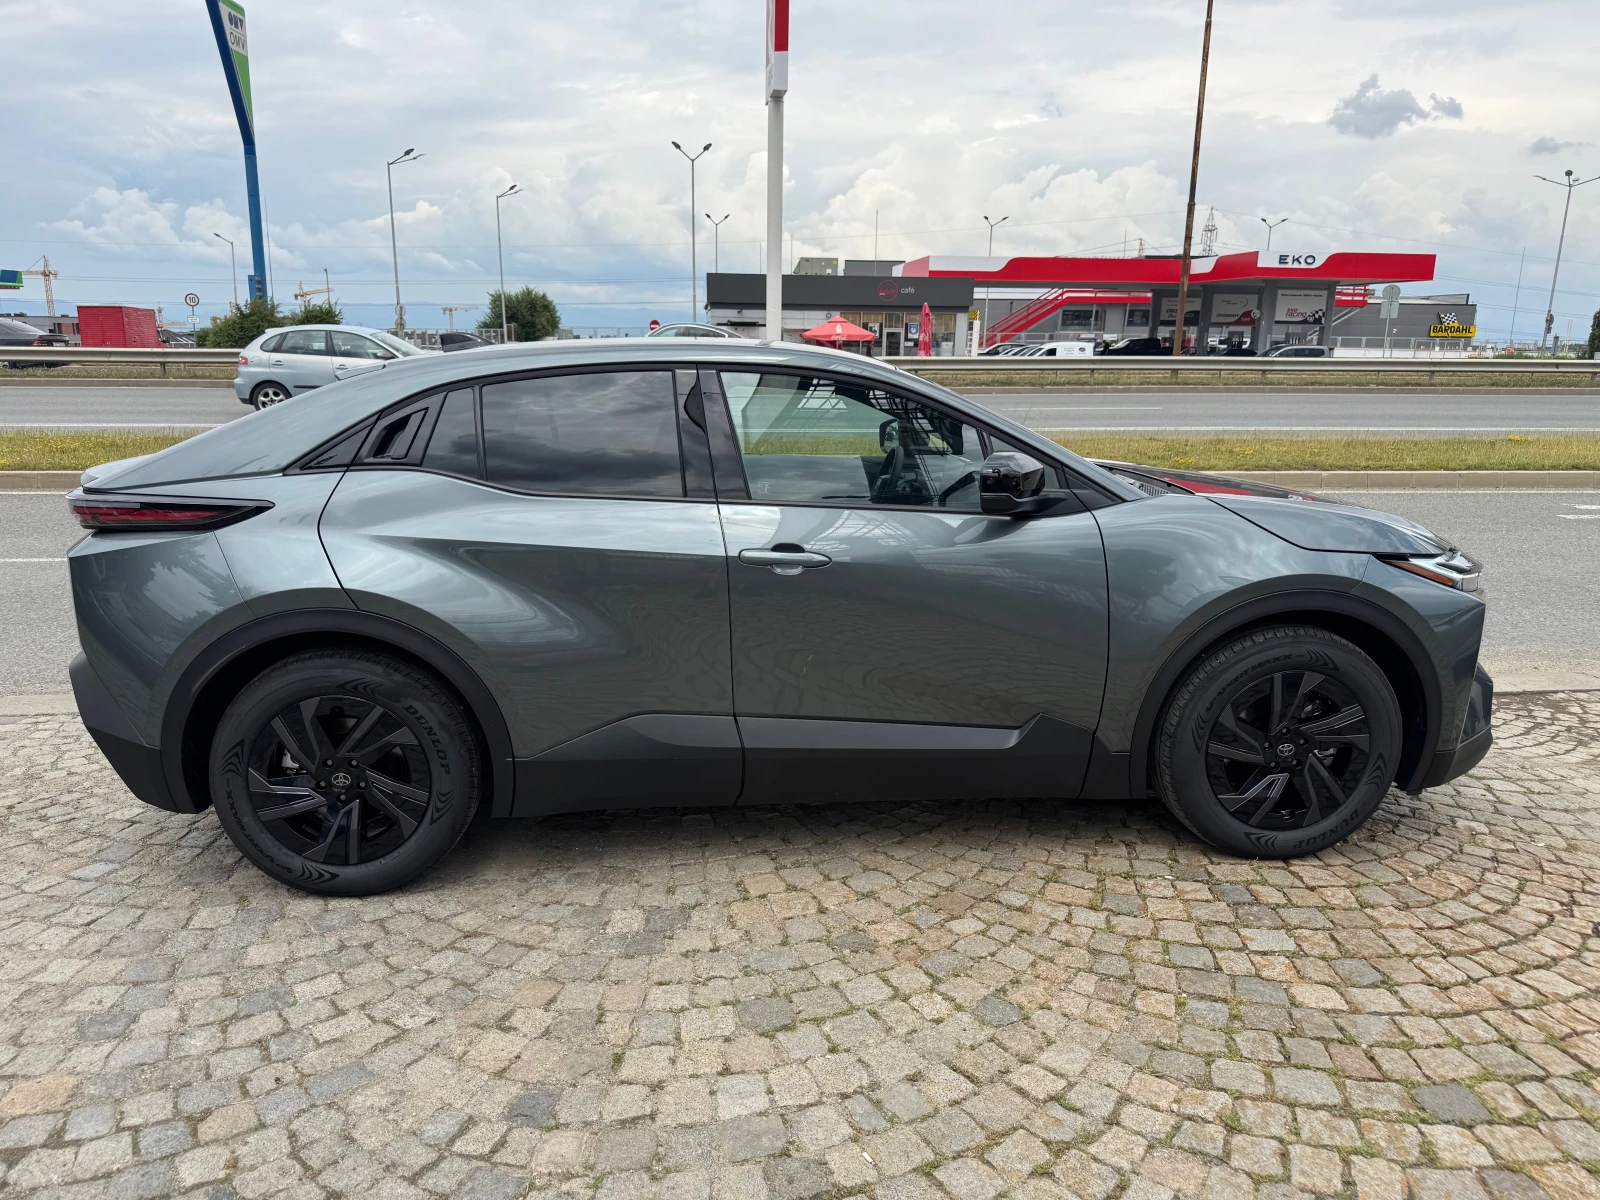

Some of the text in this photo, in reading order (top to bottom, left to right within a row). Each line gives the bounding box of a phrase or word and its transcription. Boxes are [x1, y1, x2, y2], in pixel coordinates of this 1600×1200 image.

[228, 11, 244, 31] OMV
[230, 32, 245, 50] OMV
[1278, 254, 1316, 265] EKO
[188, 296, 196, 304] 10
[1432, 325, 1473, 335] BARDAHL
[402, 703, 451, 775] DUNLOP
[1291, 807, 1360, 850] DUNLOP
